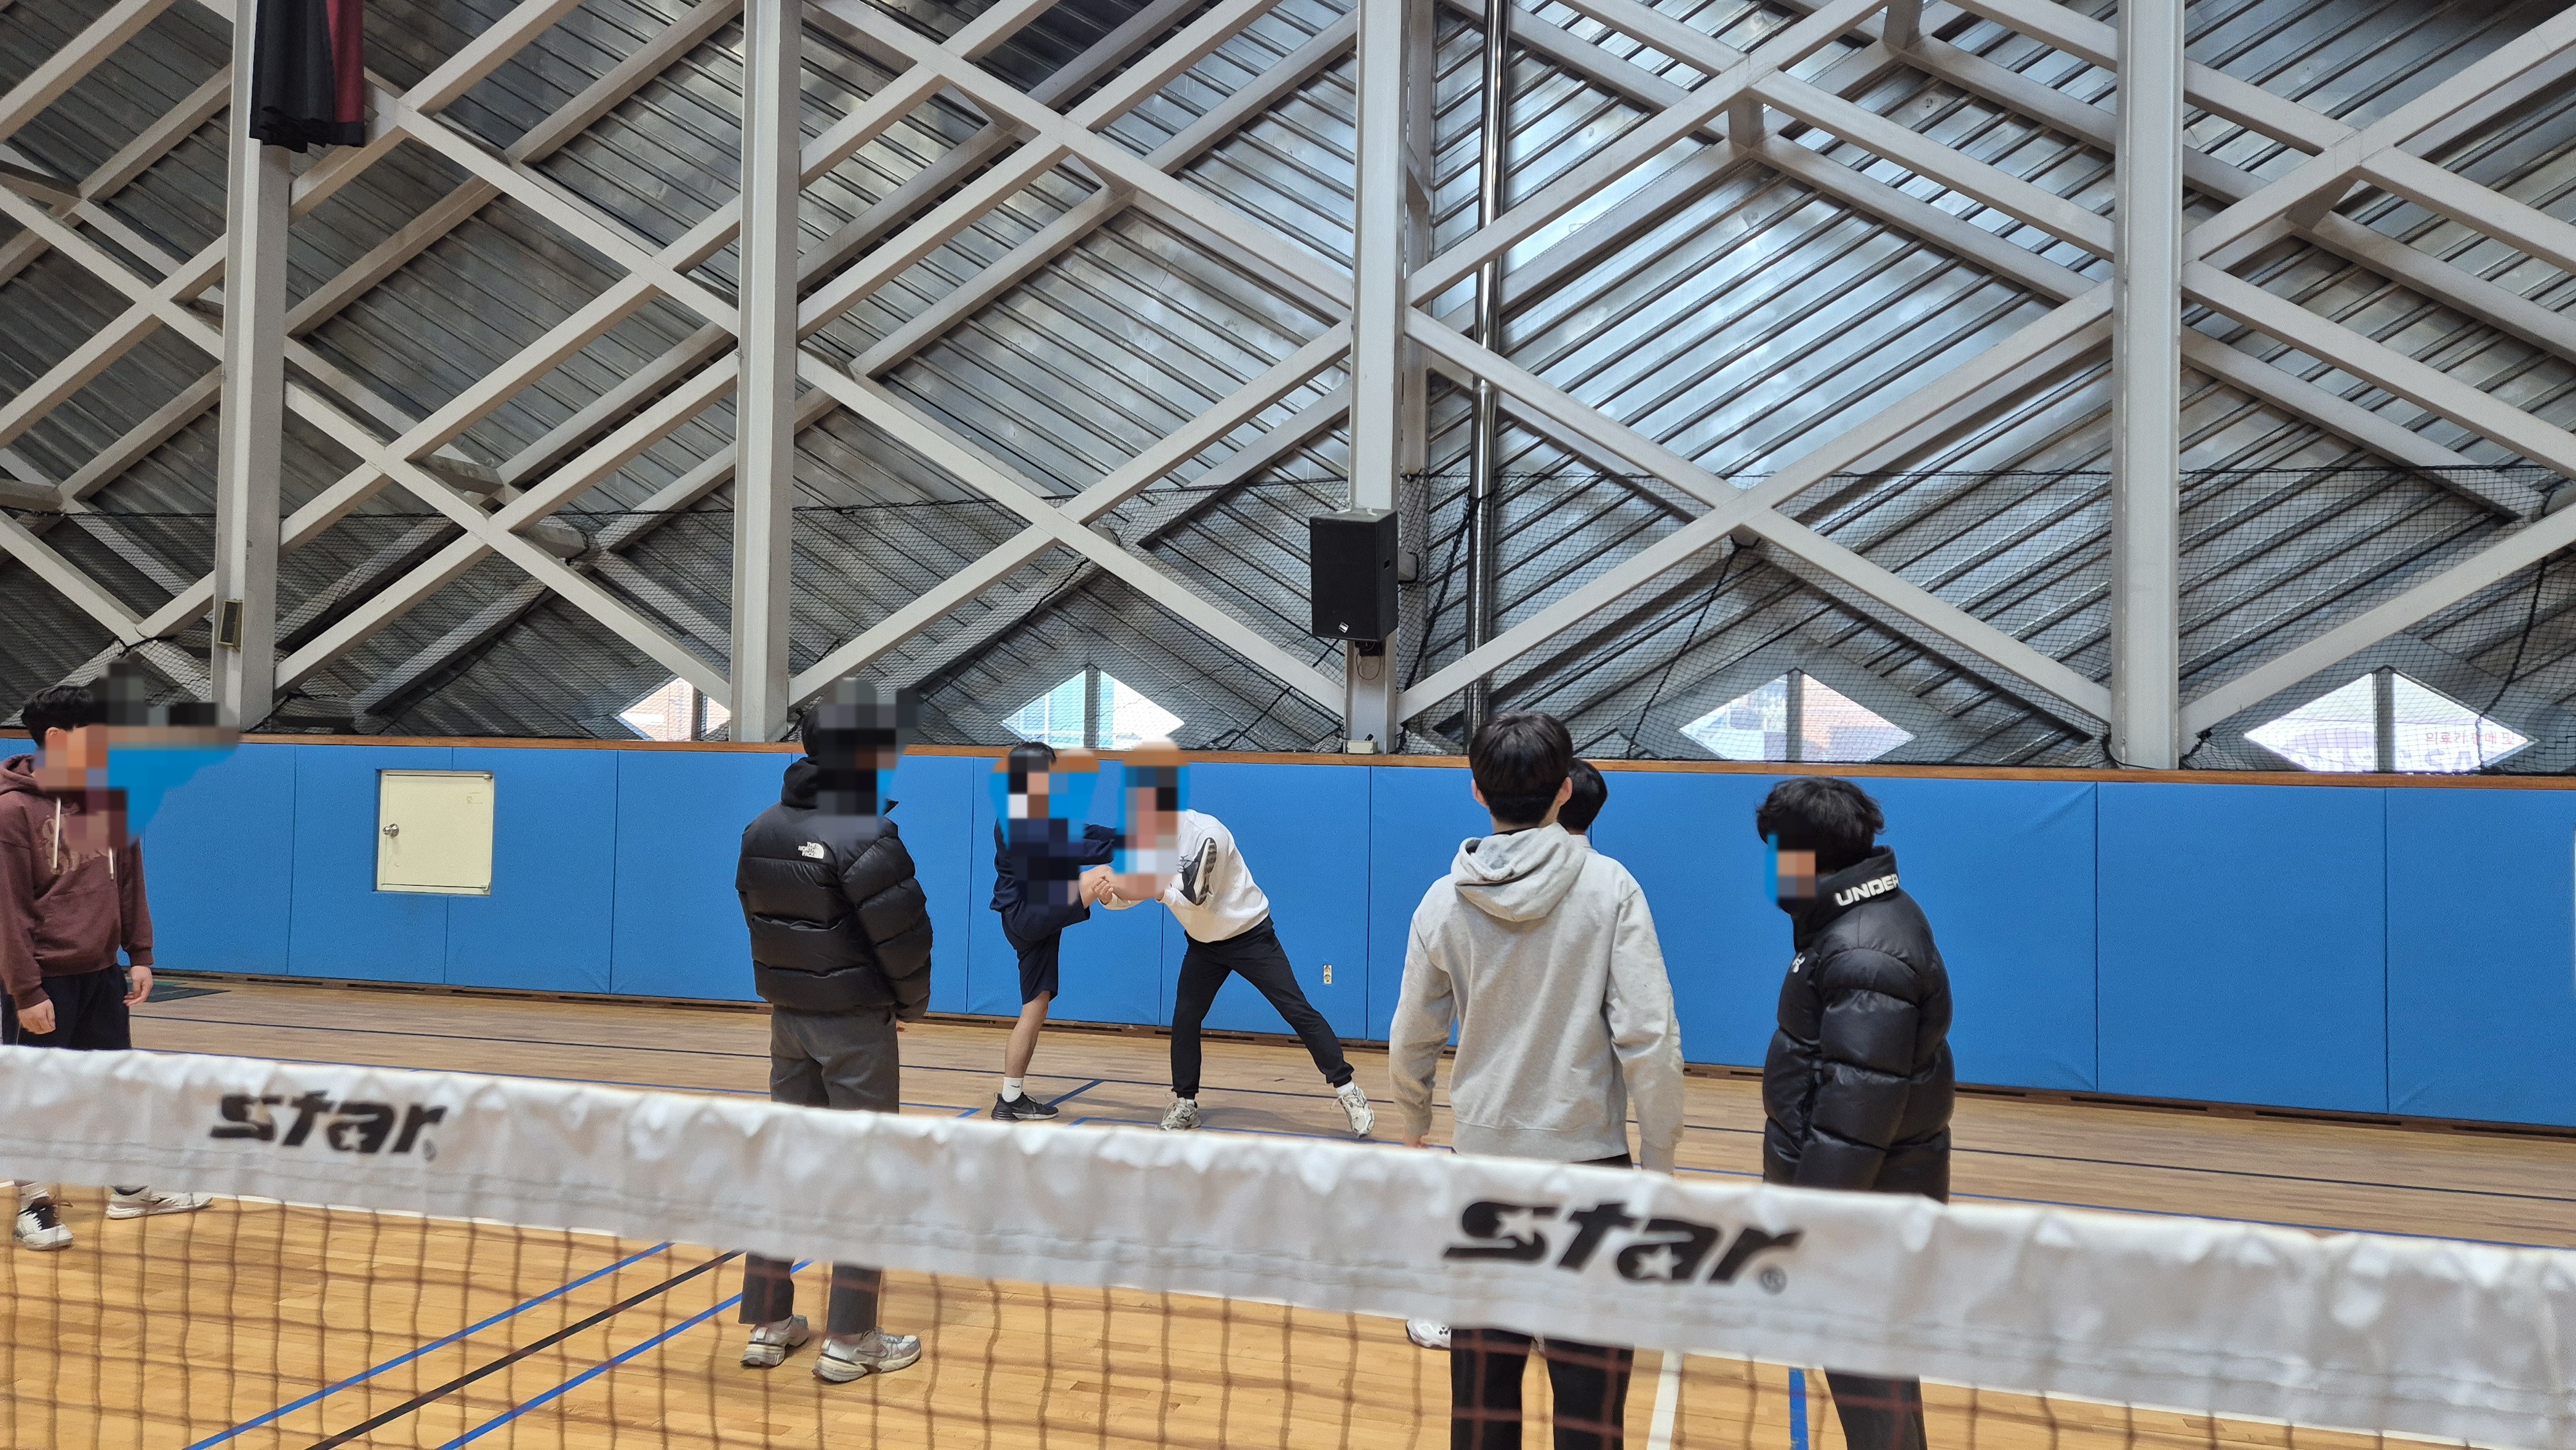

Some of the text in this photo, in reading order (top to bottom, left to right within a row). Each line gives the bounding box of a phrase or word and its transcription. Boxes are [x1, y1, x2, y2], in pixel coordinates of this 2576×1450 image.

[1835, 873, 1899, 907] UNDER
[209, 1089, 448, 1154] star
[1442, 1200, 1802, 1285] star
